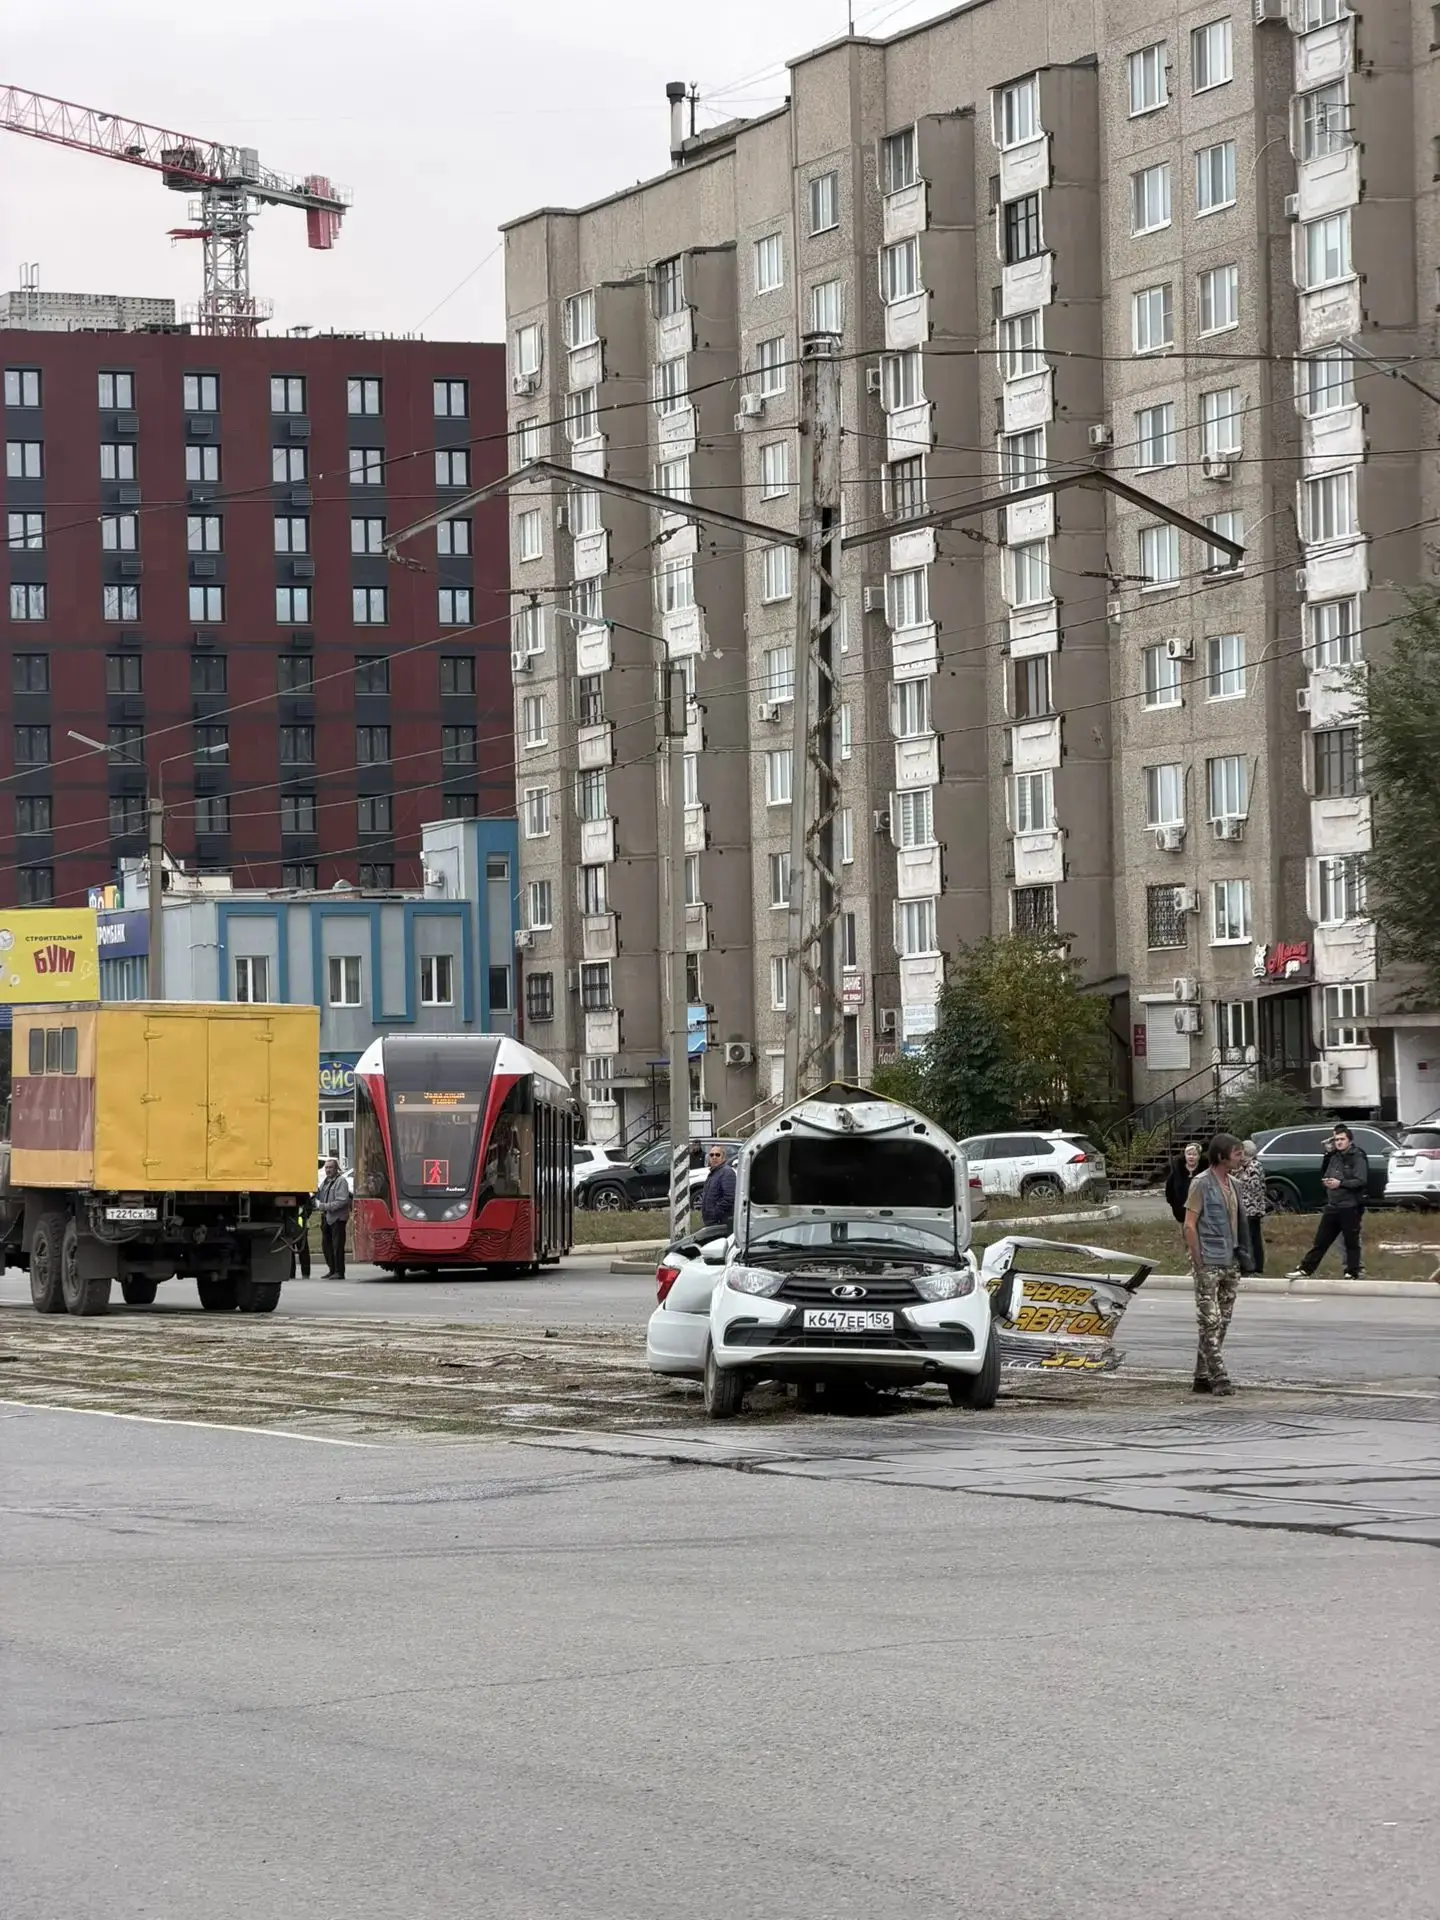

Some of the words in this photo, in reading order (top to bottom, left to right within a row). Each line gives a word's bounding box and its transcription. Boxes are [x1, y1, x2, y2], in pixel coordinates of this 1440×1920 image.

[25, 934, 83, 942] СТРОИТЕЛЬНЫЙ
[33, 944, 76, 974] БУМ
[319, 1062, 354, 1090] ейс
[399, 1094, 405, 1104] 3
[808, 1312, 866, 1328] К647ЕЕ
[868, 1313, 890, 1325] 156
